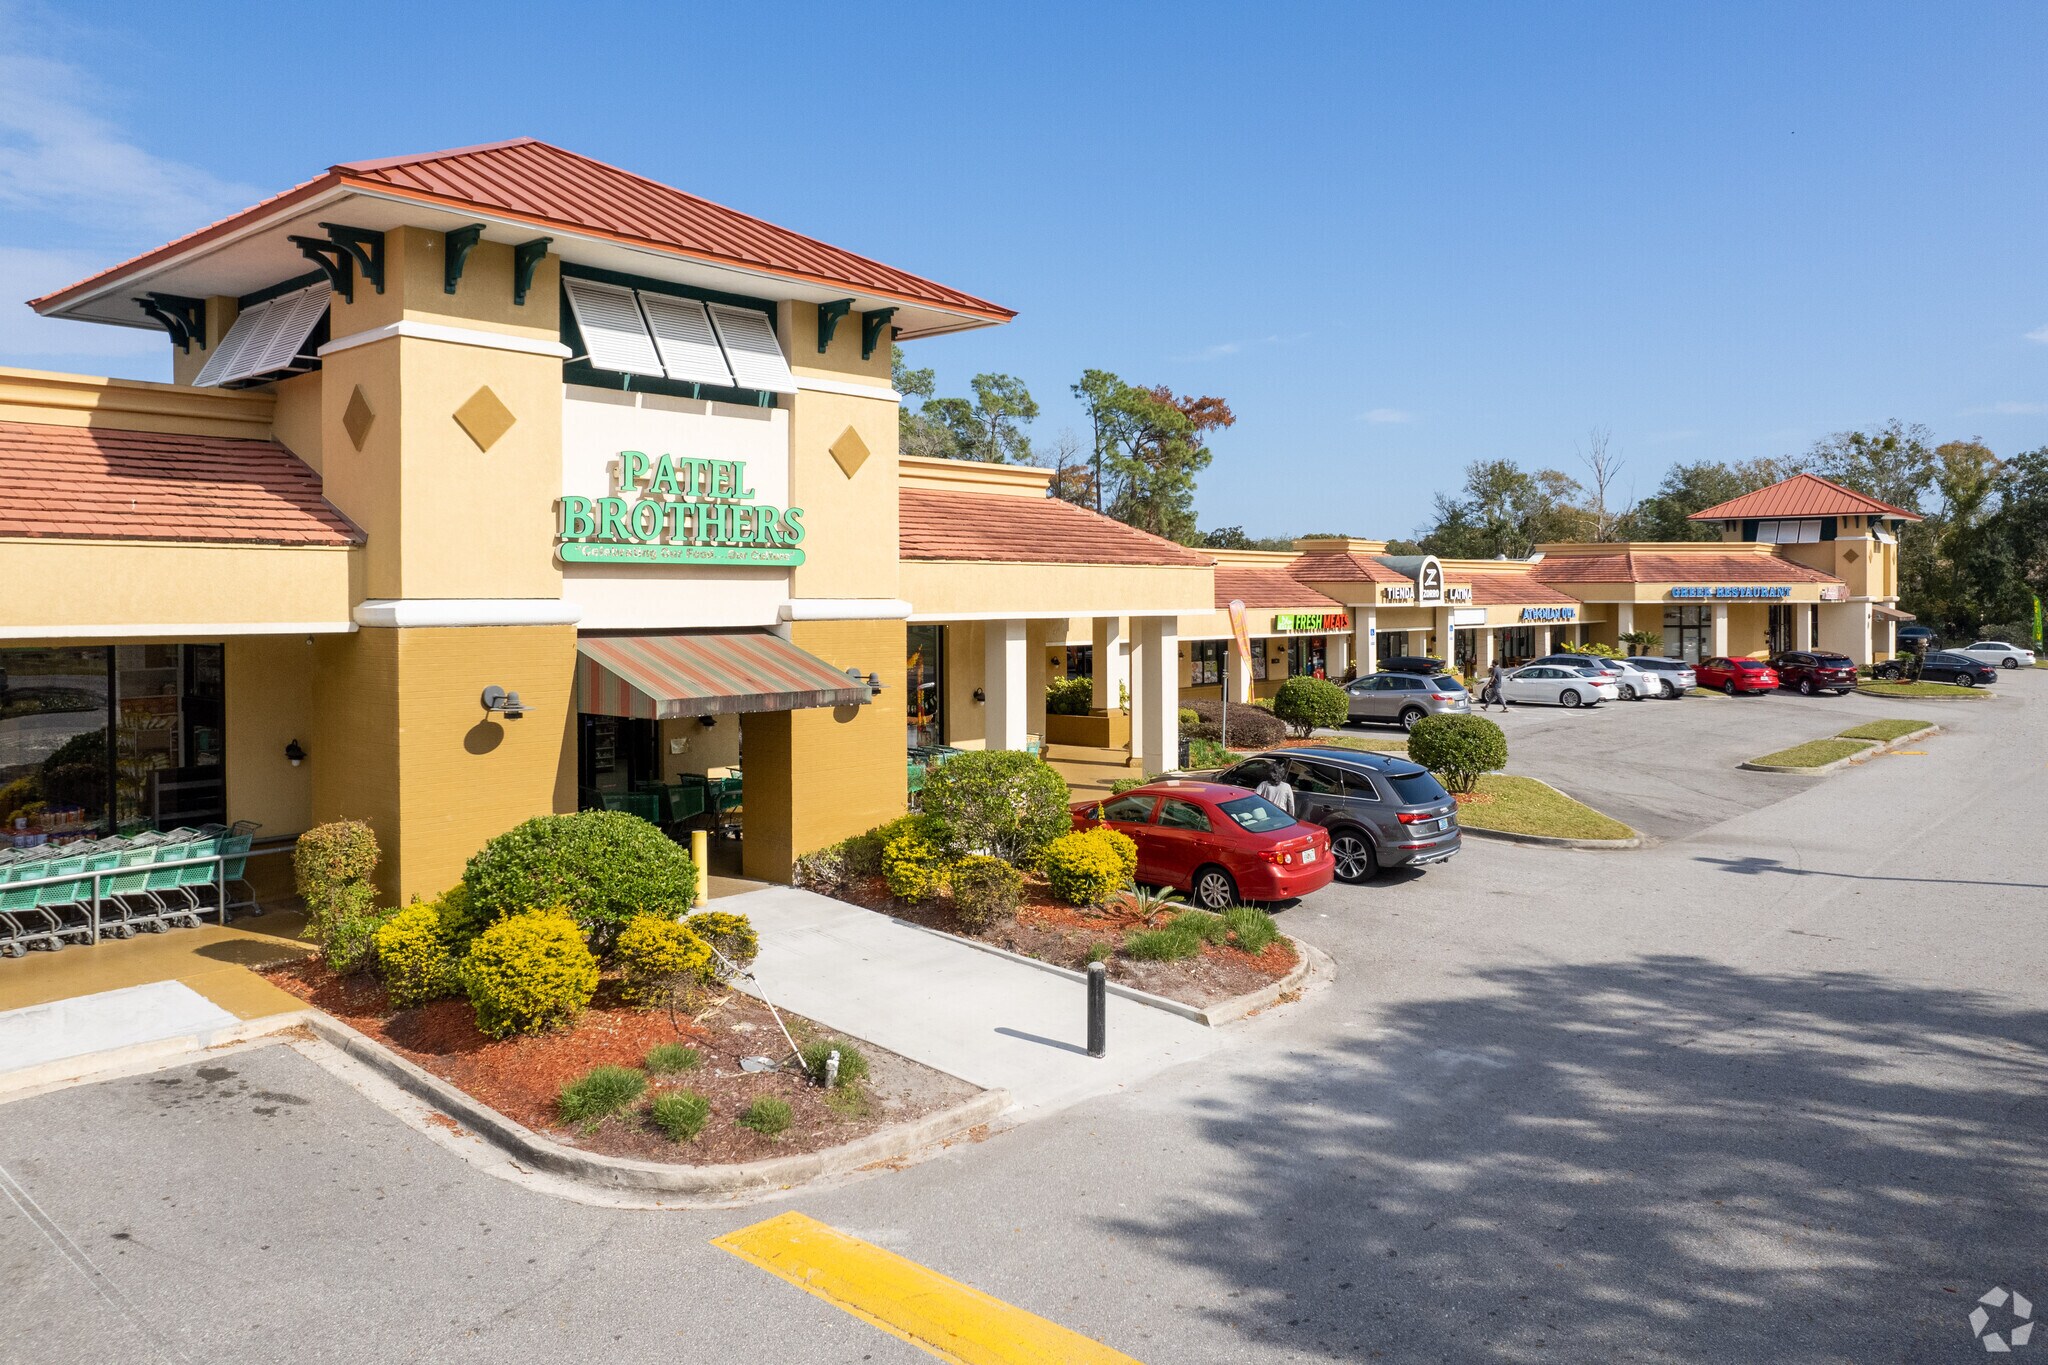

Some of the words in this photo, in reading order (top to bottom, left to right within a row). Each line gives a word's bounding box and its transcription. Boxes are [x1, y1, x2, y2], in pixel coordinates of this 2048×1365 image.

[618, 450, 755, 499] PATEL
[559, 495, 806, 545] BROTHERS
[1424, 569, 1437, 586] Z
[1387, 587, 1415, 599] TIENDA
[1423, 590, 1439, 598] ZORRO
[1450, 589, 1472, 599] LATINA
[1671, 587, 1712, 598] GREEK
[1716, 587, 1792, 598] RESTAURANT
[1522, 607, 1560, 619] ATHENIAN
[1295, 614, 1323, 629] FRESH
[1323, 614, 1349, 628] MEATS
